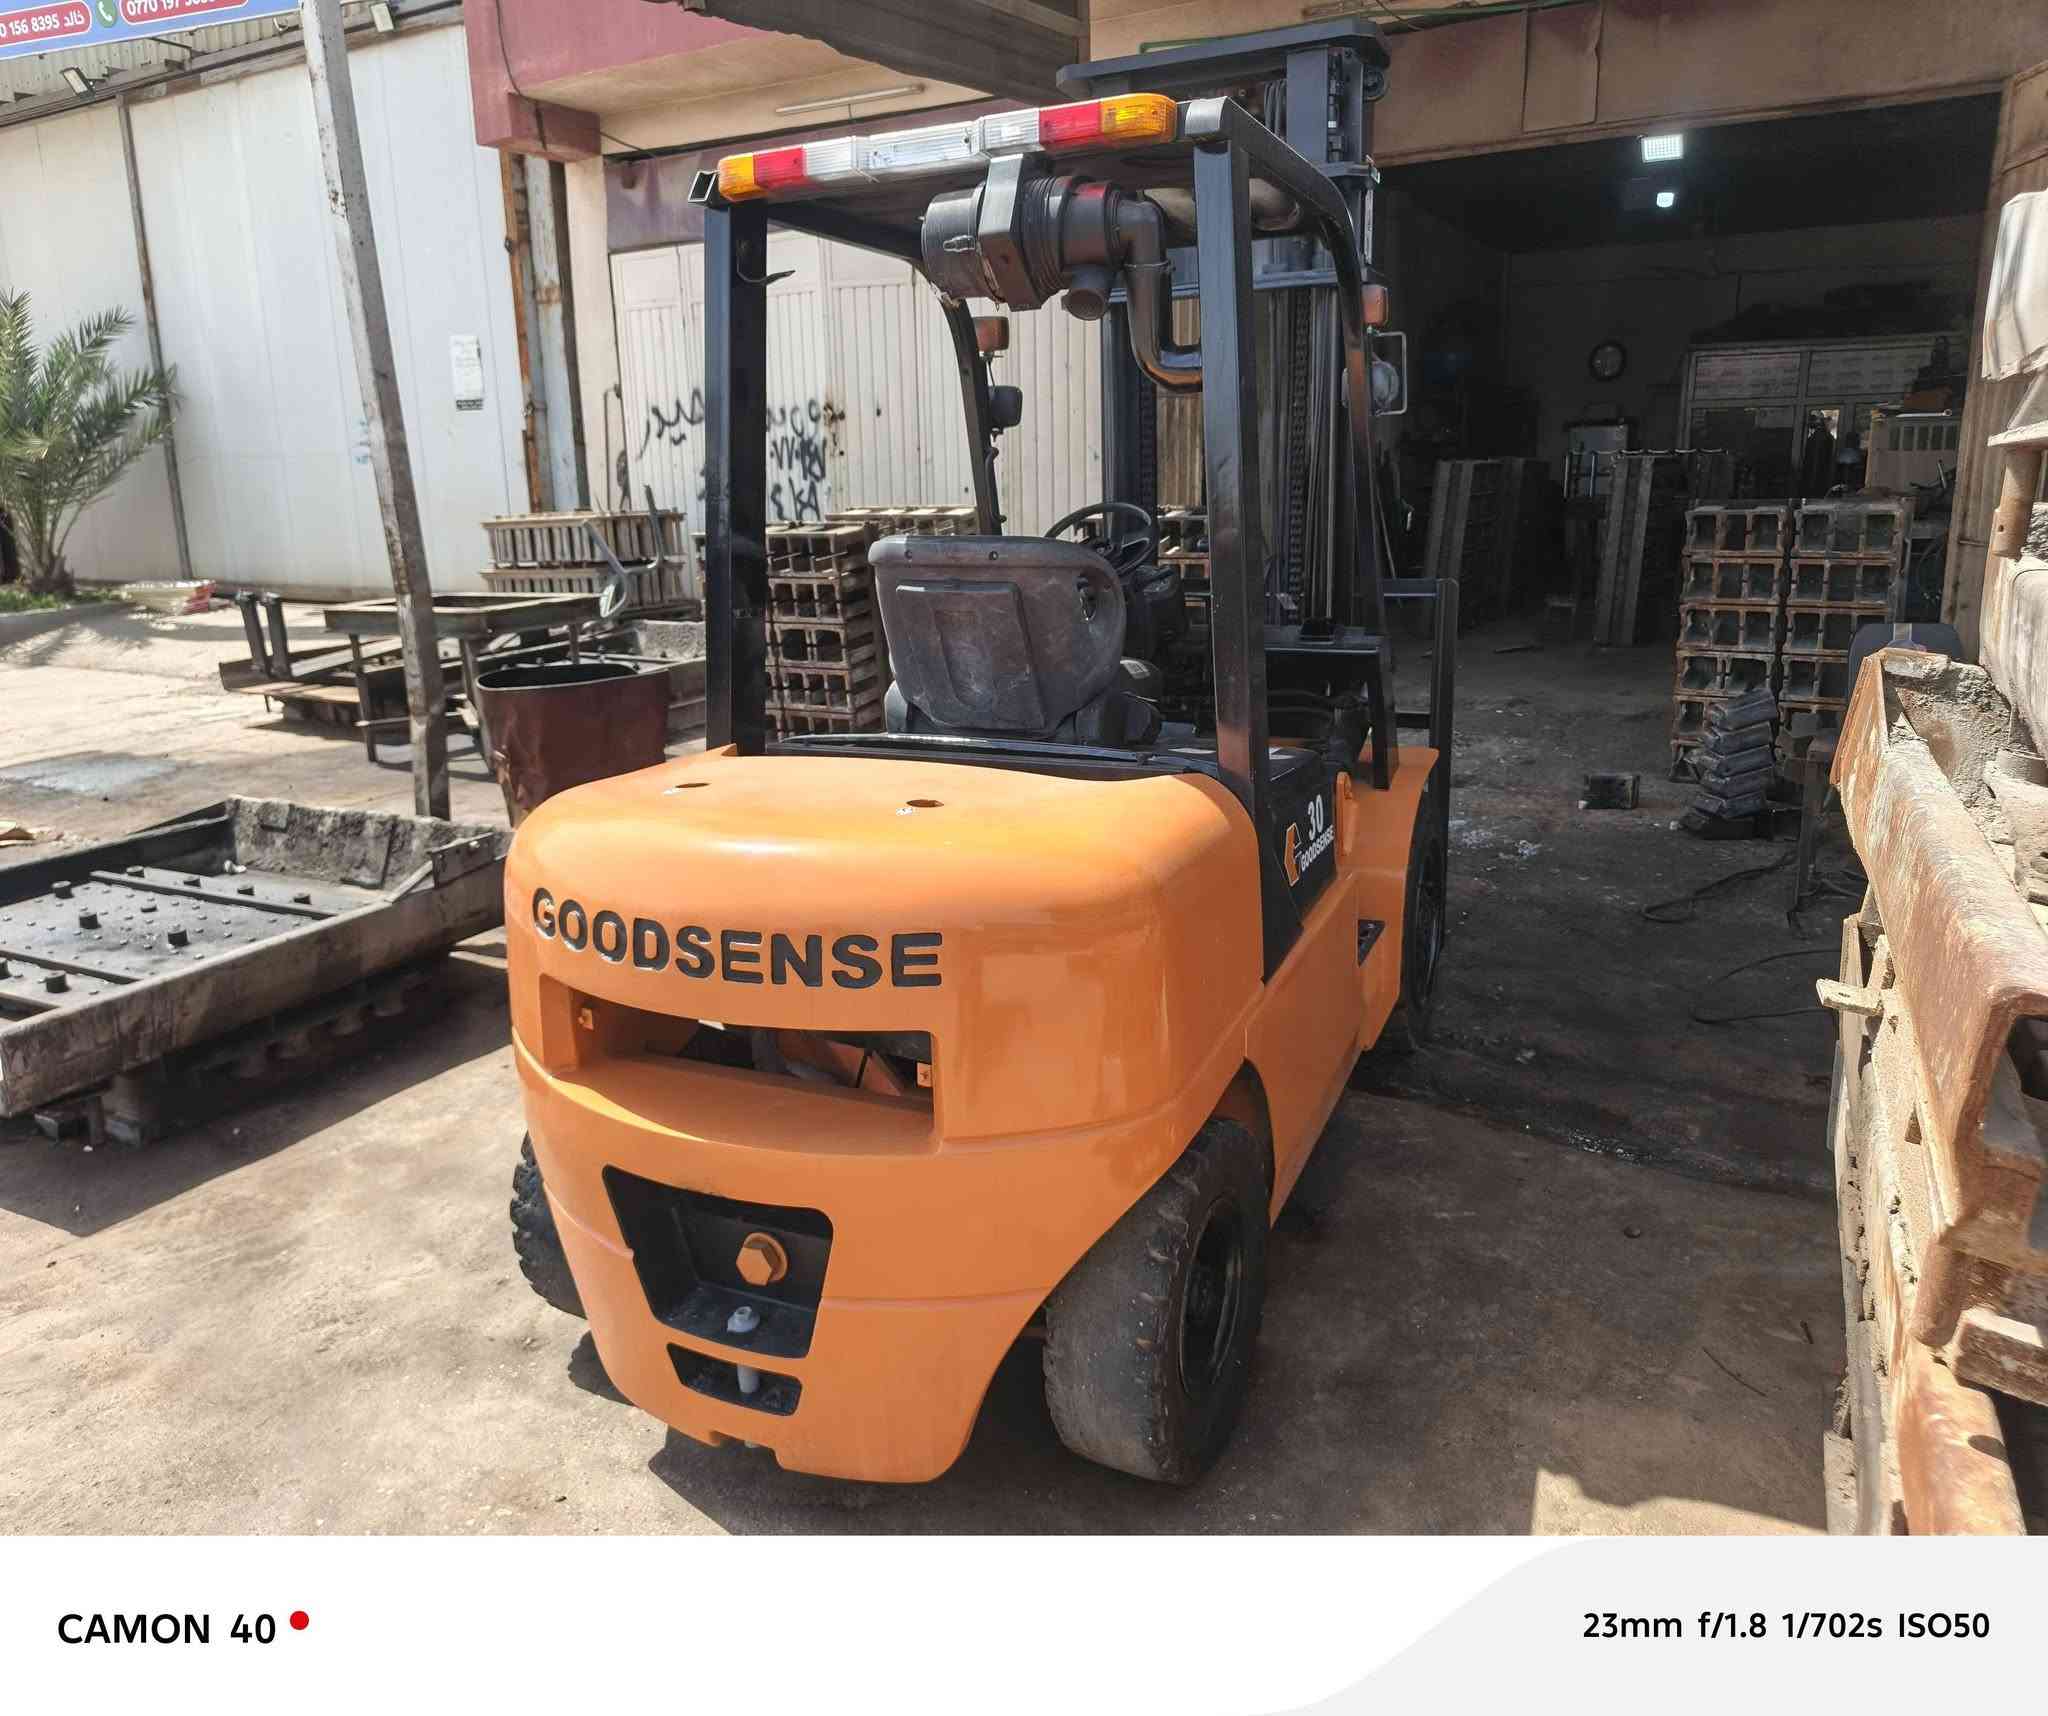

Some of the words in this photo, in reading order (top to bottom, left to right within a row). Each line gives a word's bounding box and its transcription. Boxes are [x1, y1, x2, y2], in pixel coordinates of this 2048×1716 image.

[9, 19, 29, 36] 156
[31, 13, 60, 32] 8395
[63, 10, 85, 27] خالد
[127, 0, 158, 16] 0770
[1307, 794, 1324, 841] 30
[1300, 824, 1335, 872] GOODSENSE
[532, 887, 943, 990] GOODSENSE
